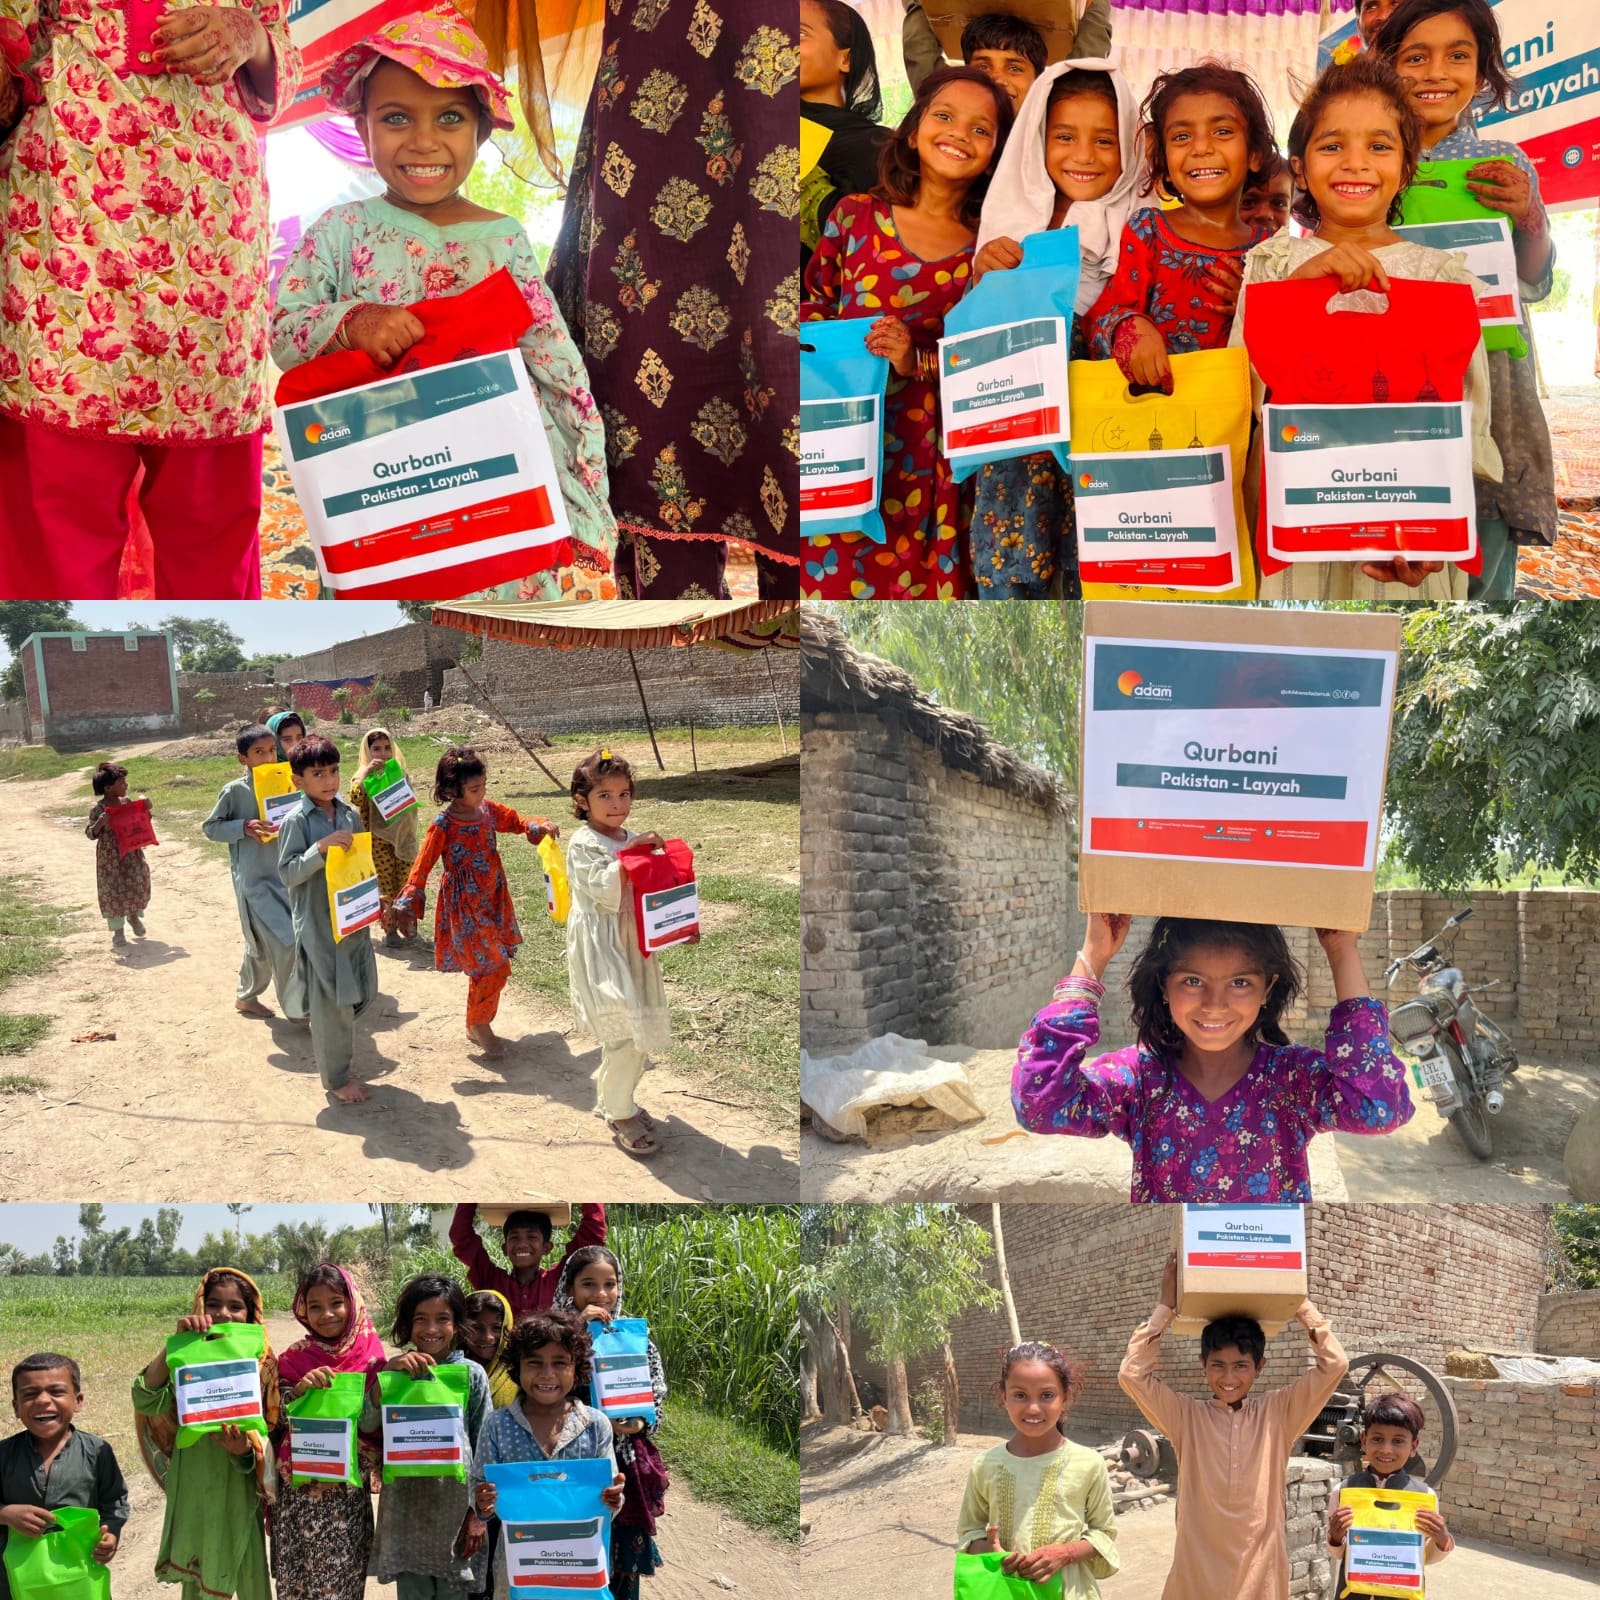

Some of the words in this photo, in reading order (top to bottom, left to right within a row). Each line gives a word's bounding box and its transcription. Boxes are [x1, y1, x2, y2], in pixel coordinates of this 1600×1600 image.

[1506, 63, 1599, 113] Layyah
[976, 375, 1014, 392] Qurbani
[968, 396, 996, 409] Pakistan
[1001, 390, 1025, 405] Layyah
[319, 426, 351, 443] adam
[1293, 431, 1320, 443] adam
[373, 446, 452, 479] Qurbani
[805, 463, 840, 475] Layyah
[1331, 468, 1398, 483] Qurbani
[361, 484, 420, 507] Pakistan
[430, 467, 480, 491] Layyah
[1088, 479, 1109, 489] adam
[1316, 491, 1365, 502] Pakistan
[1375, 490, 1417, 503] Layyah
[1118, 511, 1172, 524] Qurbani
[1107, 530, 1146, 540] Pakistan
[1154, 530, 1189, 542] Layyah
[1135, 681, 1172, 698] adam
[1183, 741, 1278, 765] Qurbani
[1160, 771, 1229, 790] Pakistan
[1243, 776, 1300, 796] Layyah
[1422, 1063, 1439, 1075] LYL
[1425, 1072, 1448, 1086] 1353
[1225, 1222, 1264, 1233] Qurbani
[1216, 1233, 1245, 1241] Pakistan
[1250, 1235, 1273, 1243] Layyah
[206, 1386, 234, 1394] Qurbani
[409, 1428, 436, 1436] Qurbani
[540, 1550, 574, 1558] Qurbani
